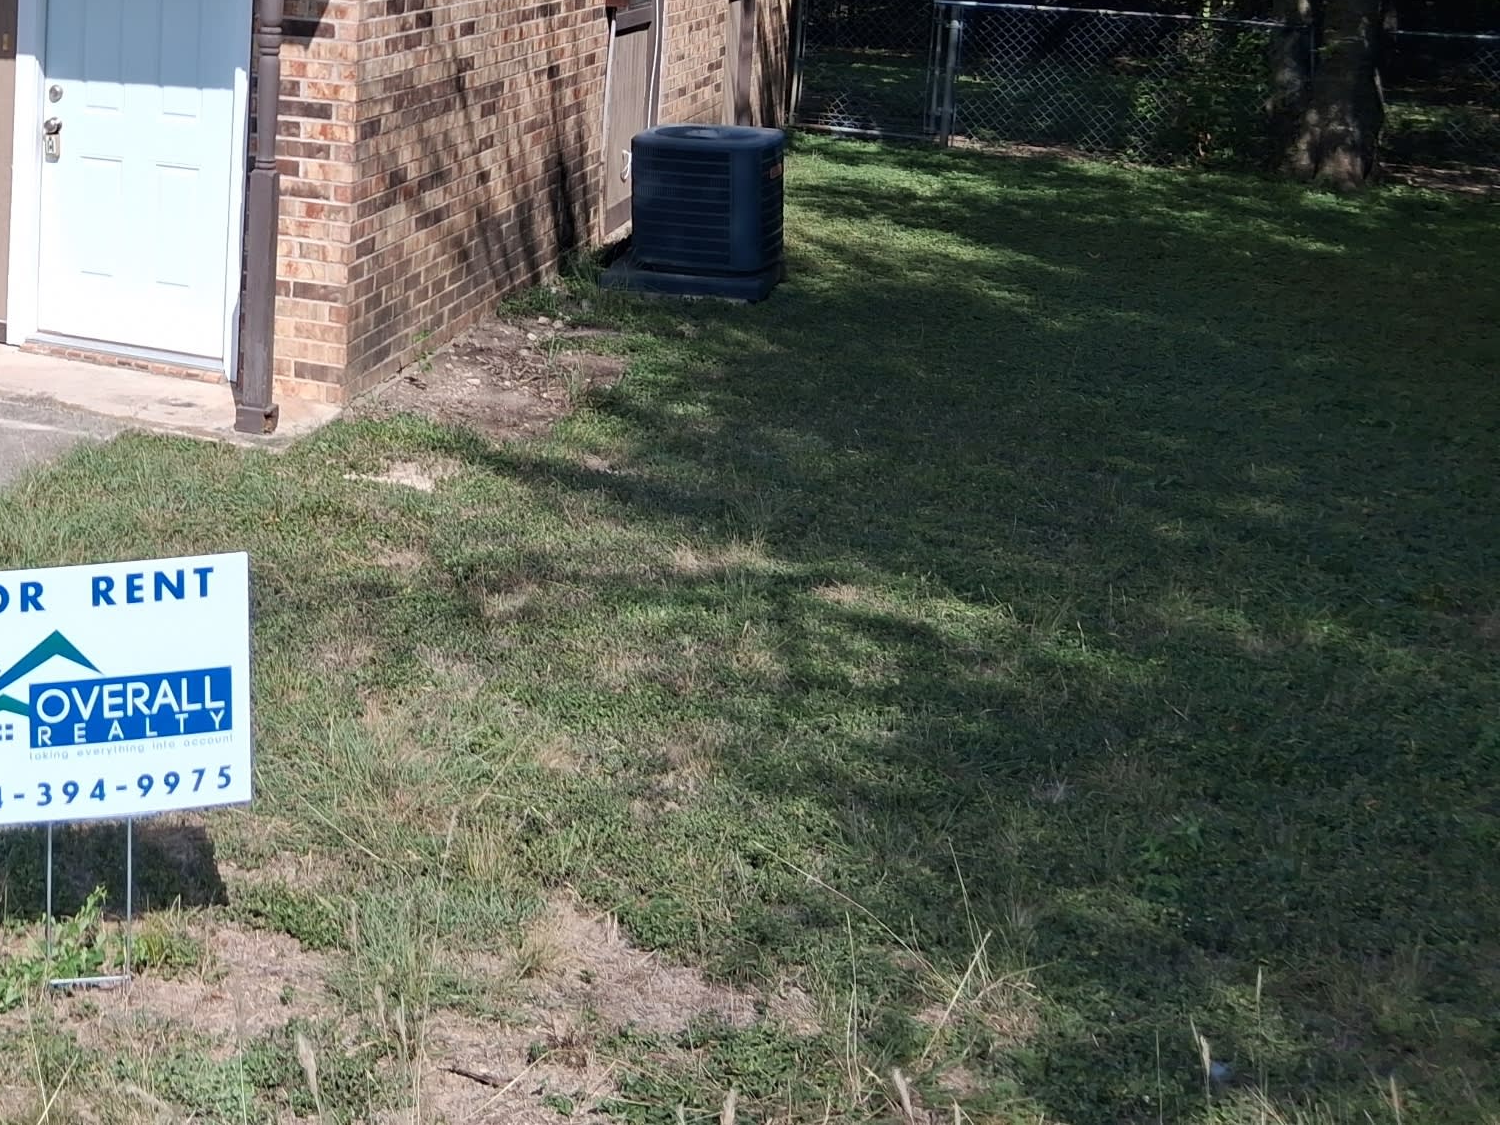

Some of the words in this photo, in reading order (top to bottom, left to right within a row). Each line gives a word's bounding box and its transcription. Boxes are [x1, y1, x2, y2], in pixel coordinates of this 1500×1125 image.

[92, 566, 214, 607] RENT
[36, 674, 225, 724] OVERALL
[29, 748, 69, 761] taking
[77, 741, 145, 758] everything
[152, 737, 176, 750] into
[184, 733, 234, 748] account
[37, 709, 225, 747] REALTY
